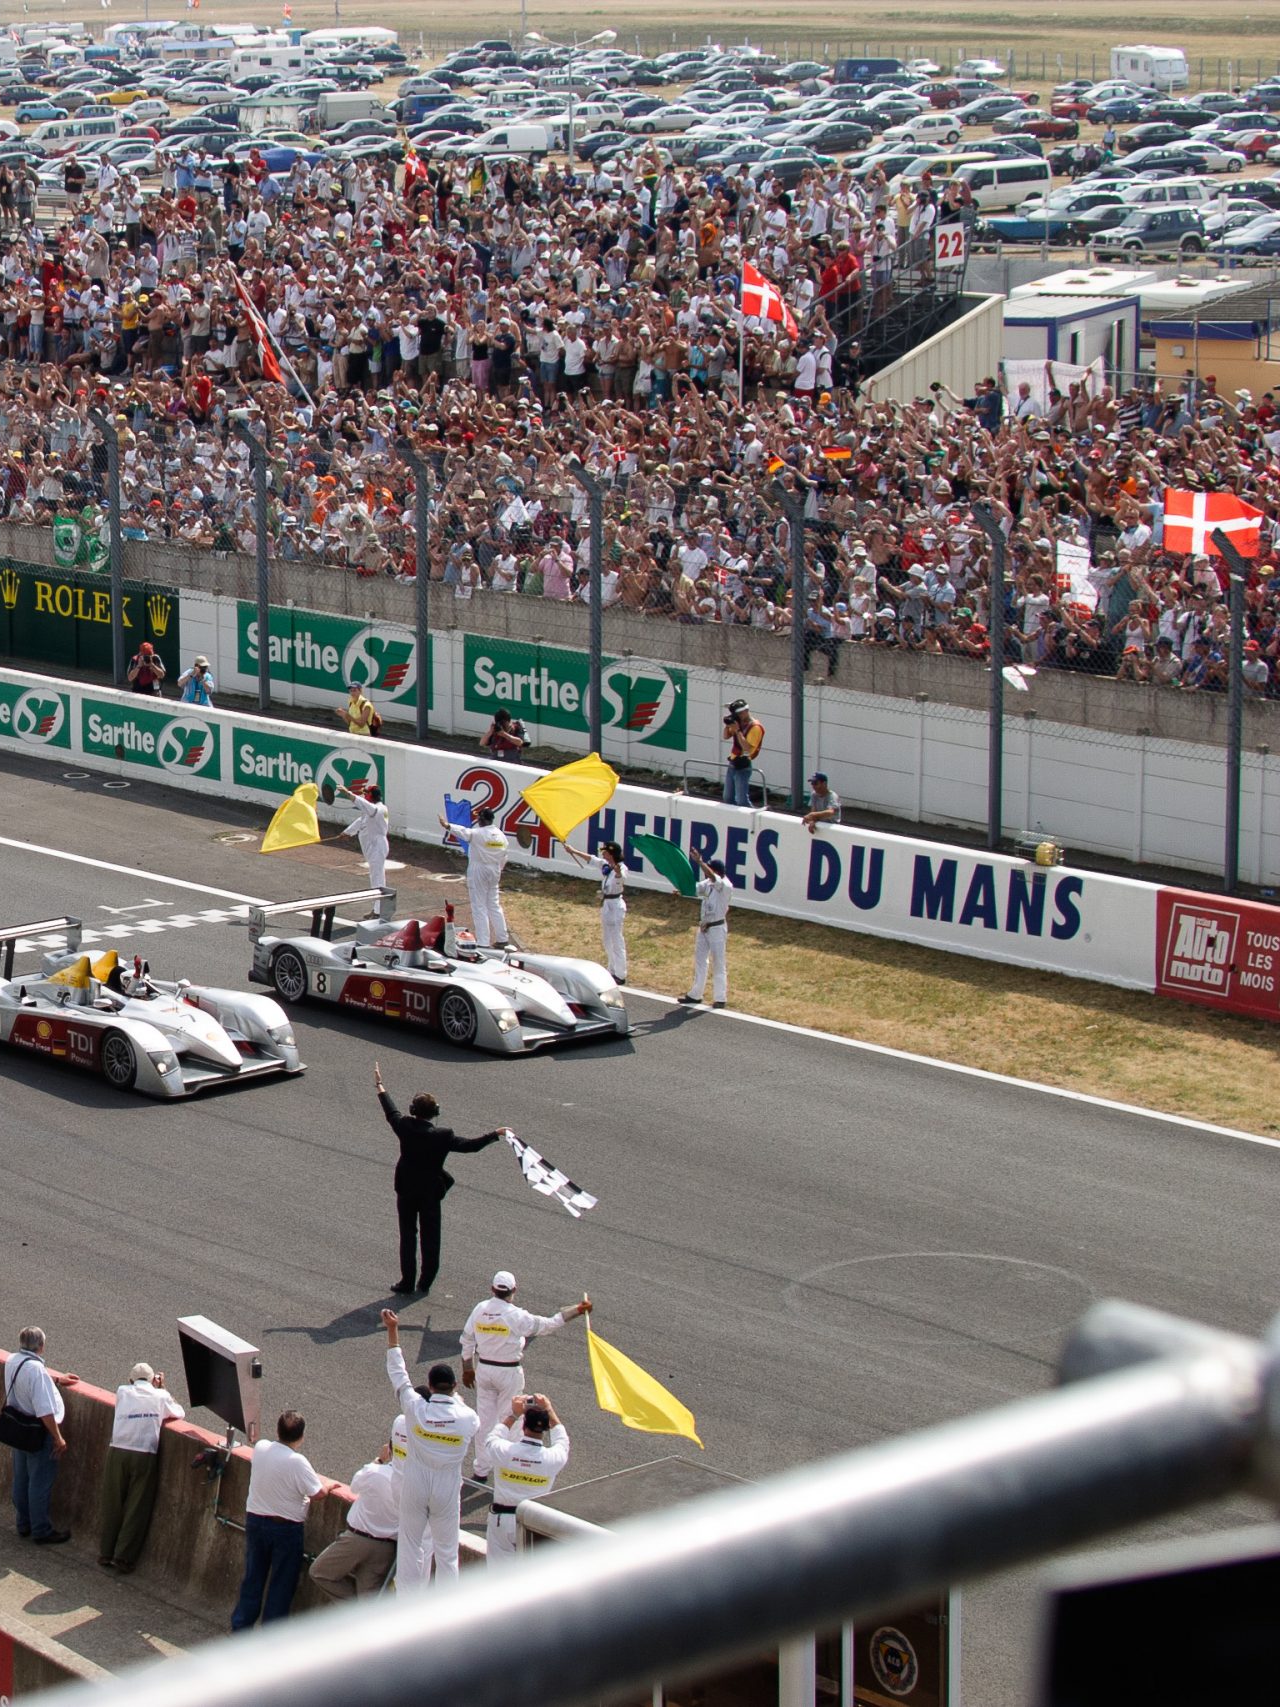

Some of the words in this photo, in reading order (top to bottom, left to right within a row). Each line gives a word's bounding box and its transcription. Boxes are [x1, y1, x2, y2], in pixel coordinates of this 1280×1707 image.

[937, 231, 963, 259] 22
[35, 581, 133, 627] ROLEX
[247, 621, 339, 673] Sarthe
[474, 656, 579, 711] Sarthe
[88, 713, 155, 753] Sarthe
[240, 744, 312, 783] Sarthe
[442, 766, 556, 859] 24
[807, 839, 884, 910] DU
[910, 854, 1083, 940] MANS
[1173, 914, 1229, 964] Auto
[1246, 931, 1280, 951] TOUS
[1170, 960, 1223, 985] moto
[1248, 952, 1273, 970] LES
[317, 972, 326, 993] 8
[1240, 971, 1274, 991] MOIS
[402, 989, 430, 1012] TDI
[67, 1030, 93, 1054] TDI
[71, 1052, 93, 1066] Power
[422, 1432, 461, 1443] DUNLOP
[510, 1473, 548, 1484] DUNLOP
